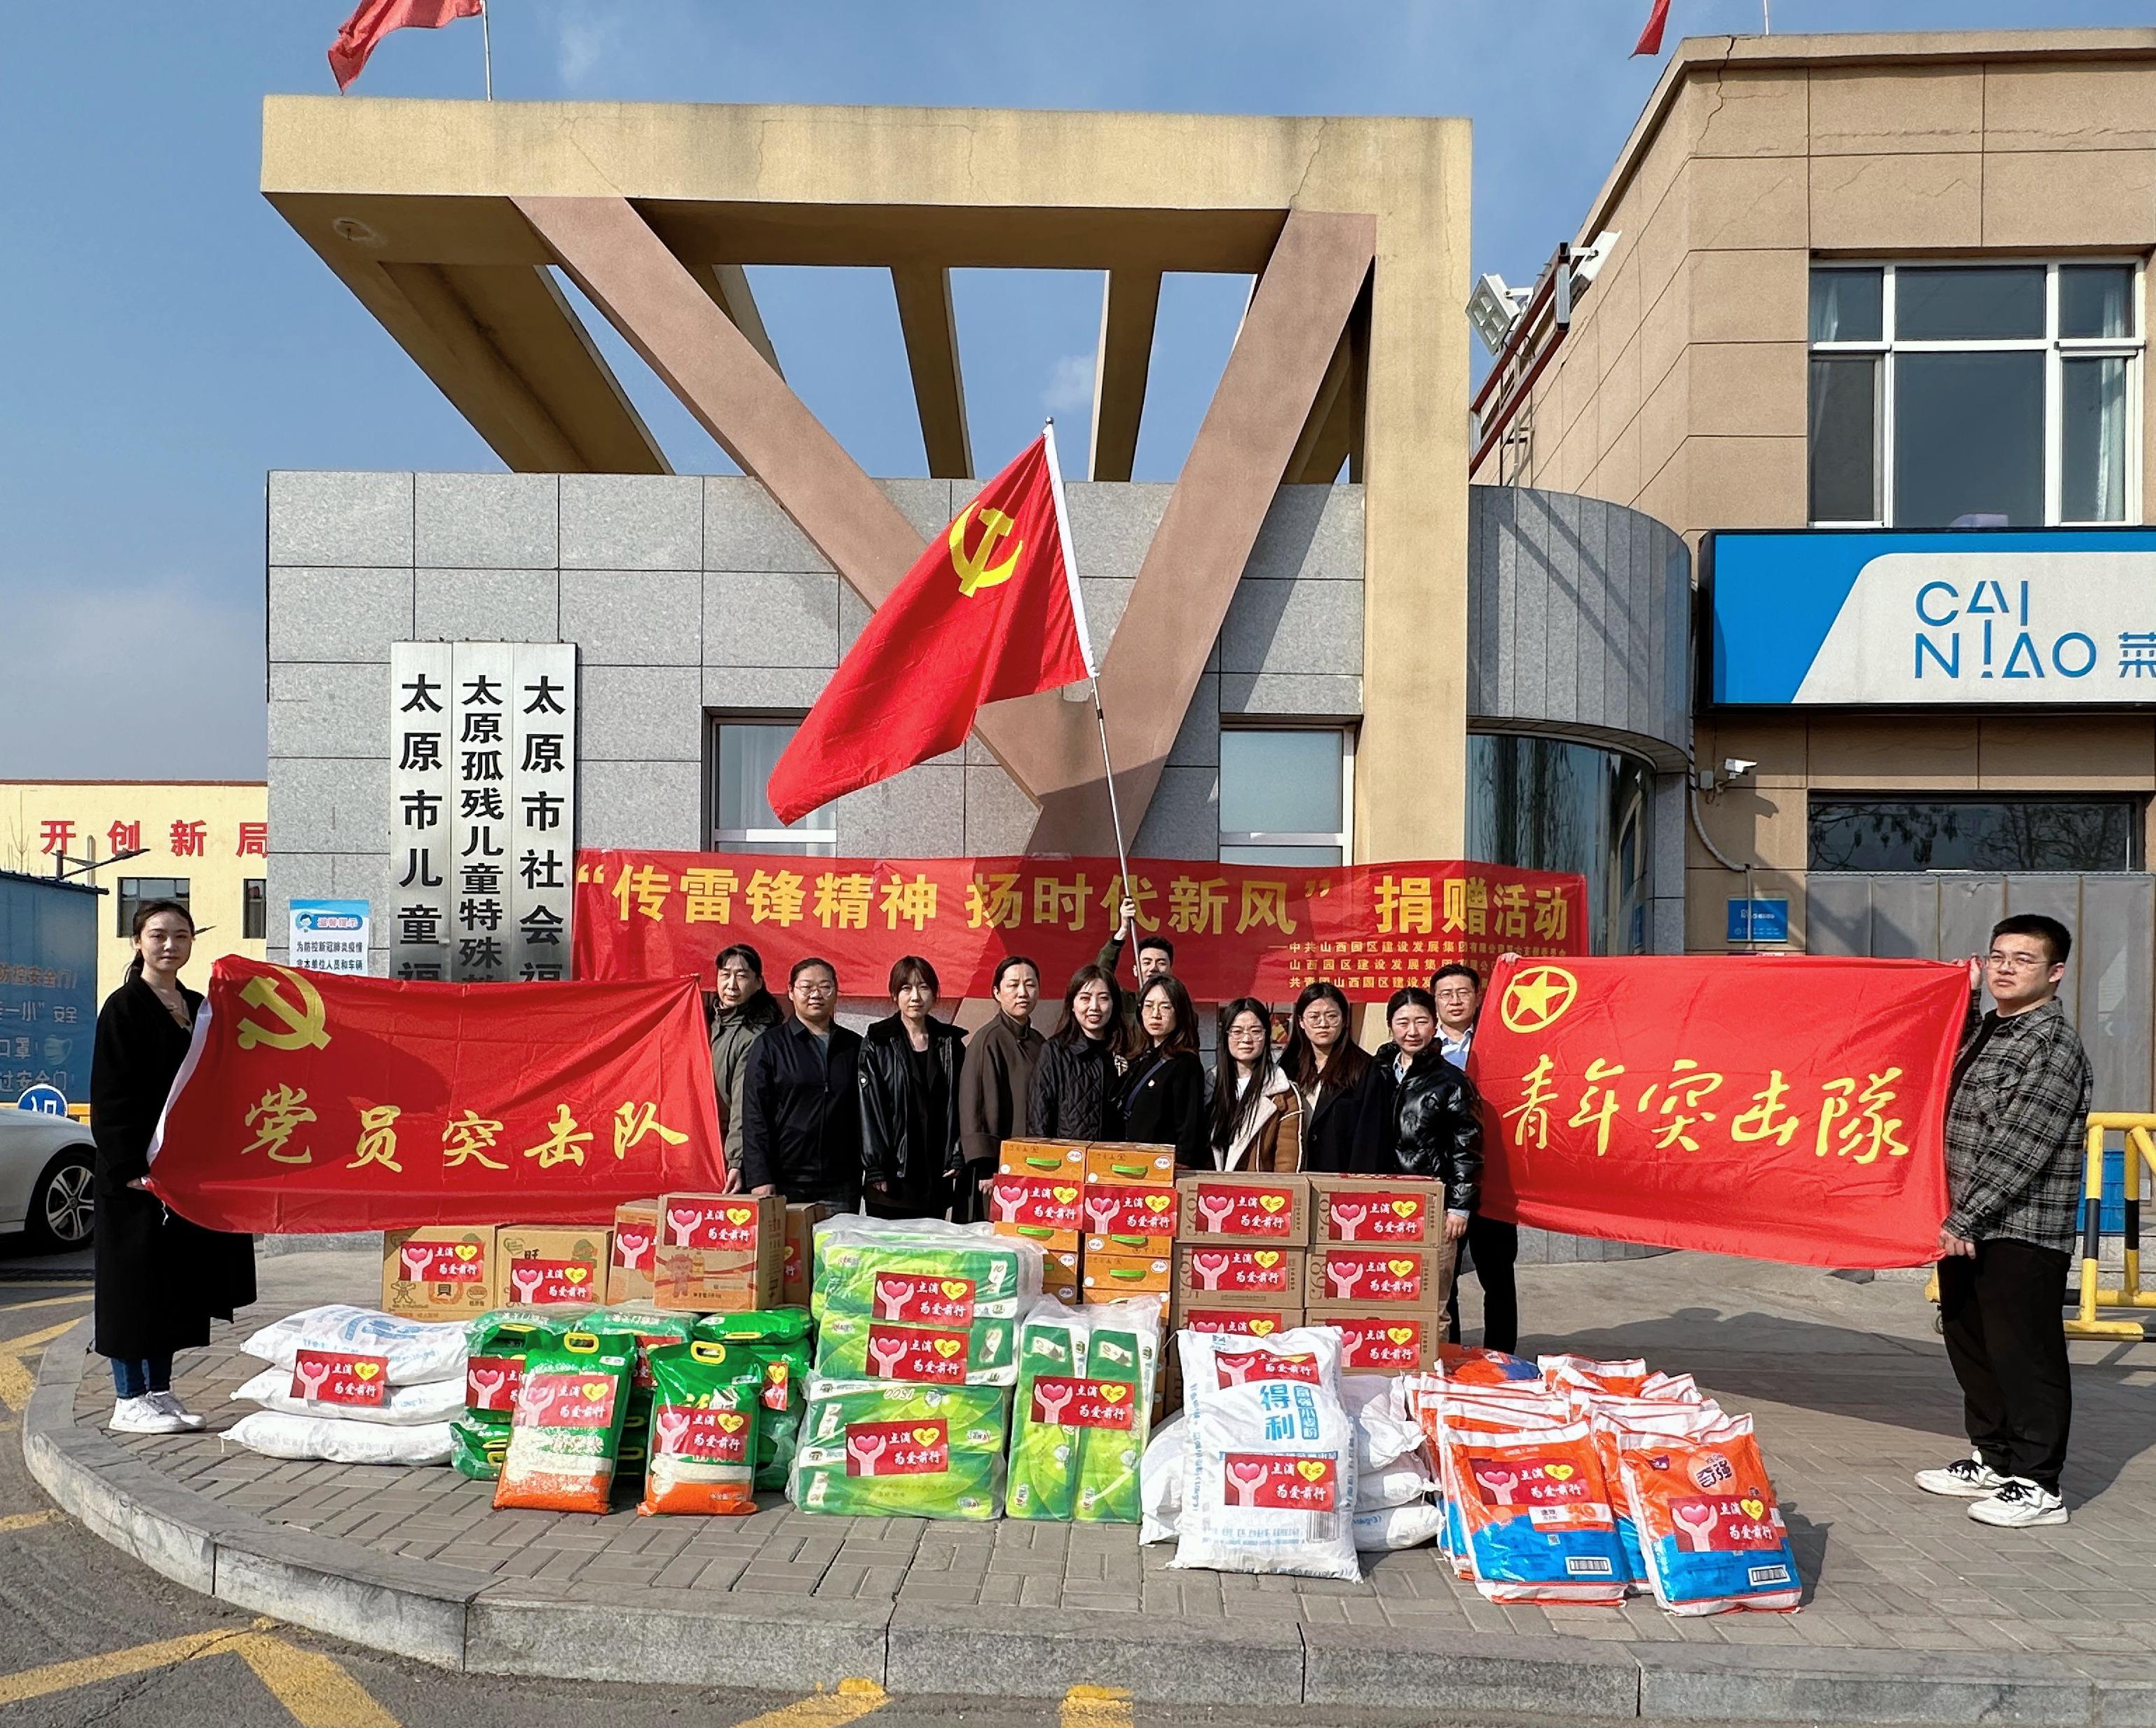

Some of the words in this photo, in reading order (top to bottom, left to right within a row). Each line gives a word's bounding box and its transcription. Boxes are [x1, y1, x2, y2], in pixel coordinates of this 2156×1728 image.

[1916, 580, 2030, 627] CAI
[40, 819, 268, 858] 开创新局
[459, 674, 505, 983] 太原孤残儿童特殊
[1374, 874, 1568, 941] 捐赠活动
[240, 1082, 690, 1173] 党员突击队
[1260, 1383, 1295, 1441] 得利
